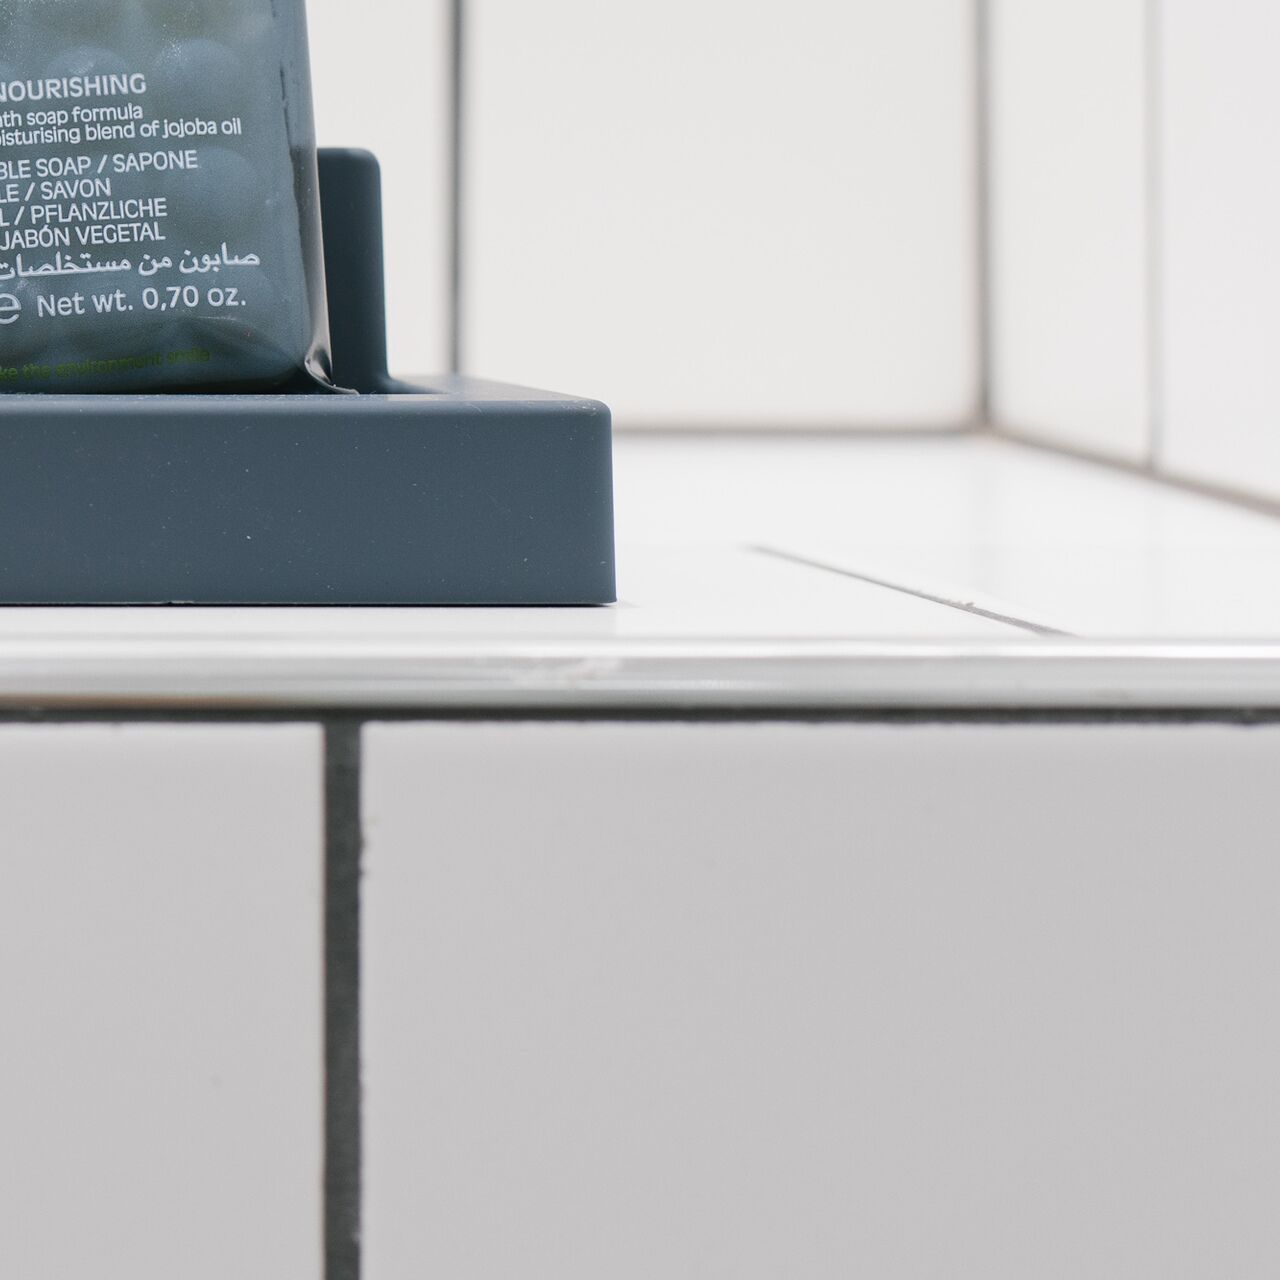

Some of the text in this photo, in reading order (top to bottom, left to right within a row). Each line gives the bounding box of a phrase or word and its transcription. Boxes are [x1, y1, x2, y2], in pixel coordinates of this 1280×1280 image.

[27, 111, 67, 129] soap
[72, 103, 143, 122] formula
[86, 121, 135, 140] blend
[163, 119, 217, 139] jojoba
[222, 118, 241, 135] oil
[35, 156, 91, 177] SOAP
[112, 150, 198, 172] SAPONE
[41, 178, 112, 200] SAVON
[31, 198, 167, 225] PFLANZLICHE
[0, 225, 70, 251] JABÓN
[75, 221, 166, 245] VEGETAL
[138, 251, 172, 276] من
[37, 292, 85, 317] Net
[91, 289, 134, 313] wt.
[142, 285, 199, 312] 0,70
[207, 287, 246, 307] oz.
